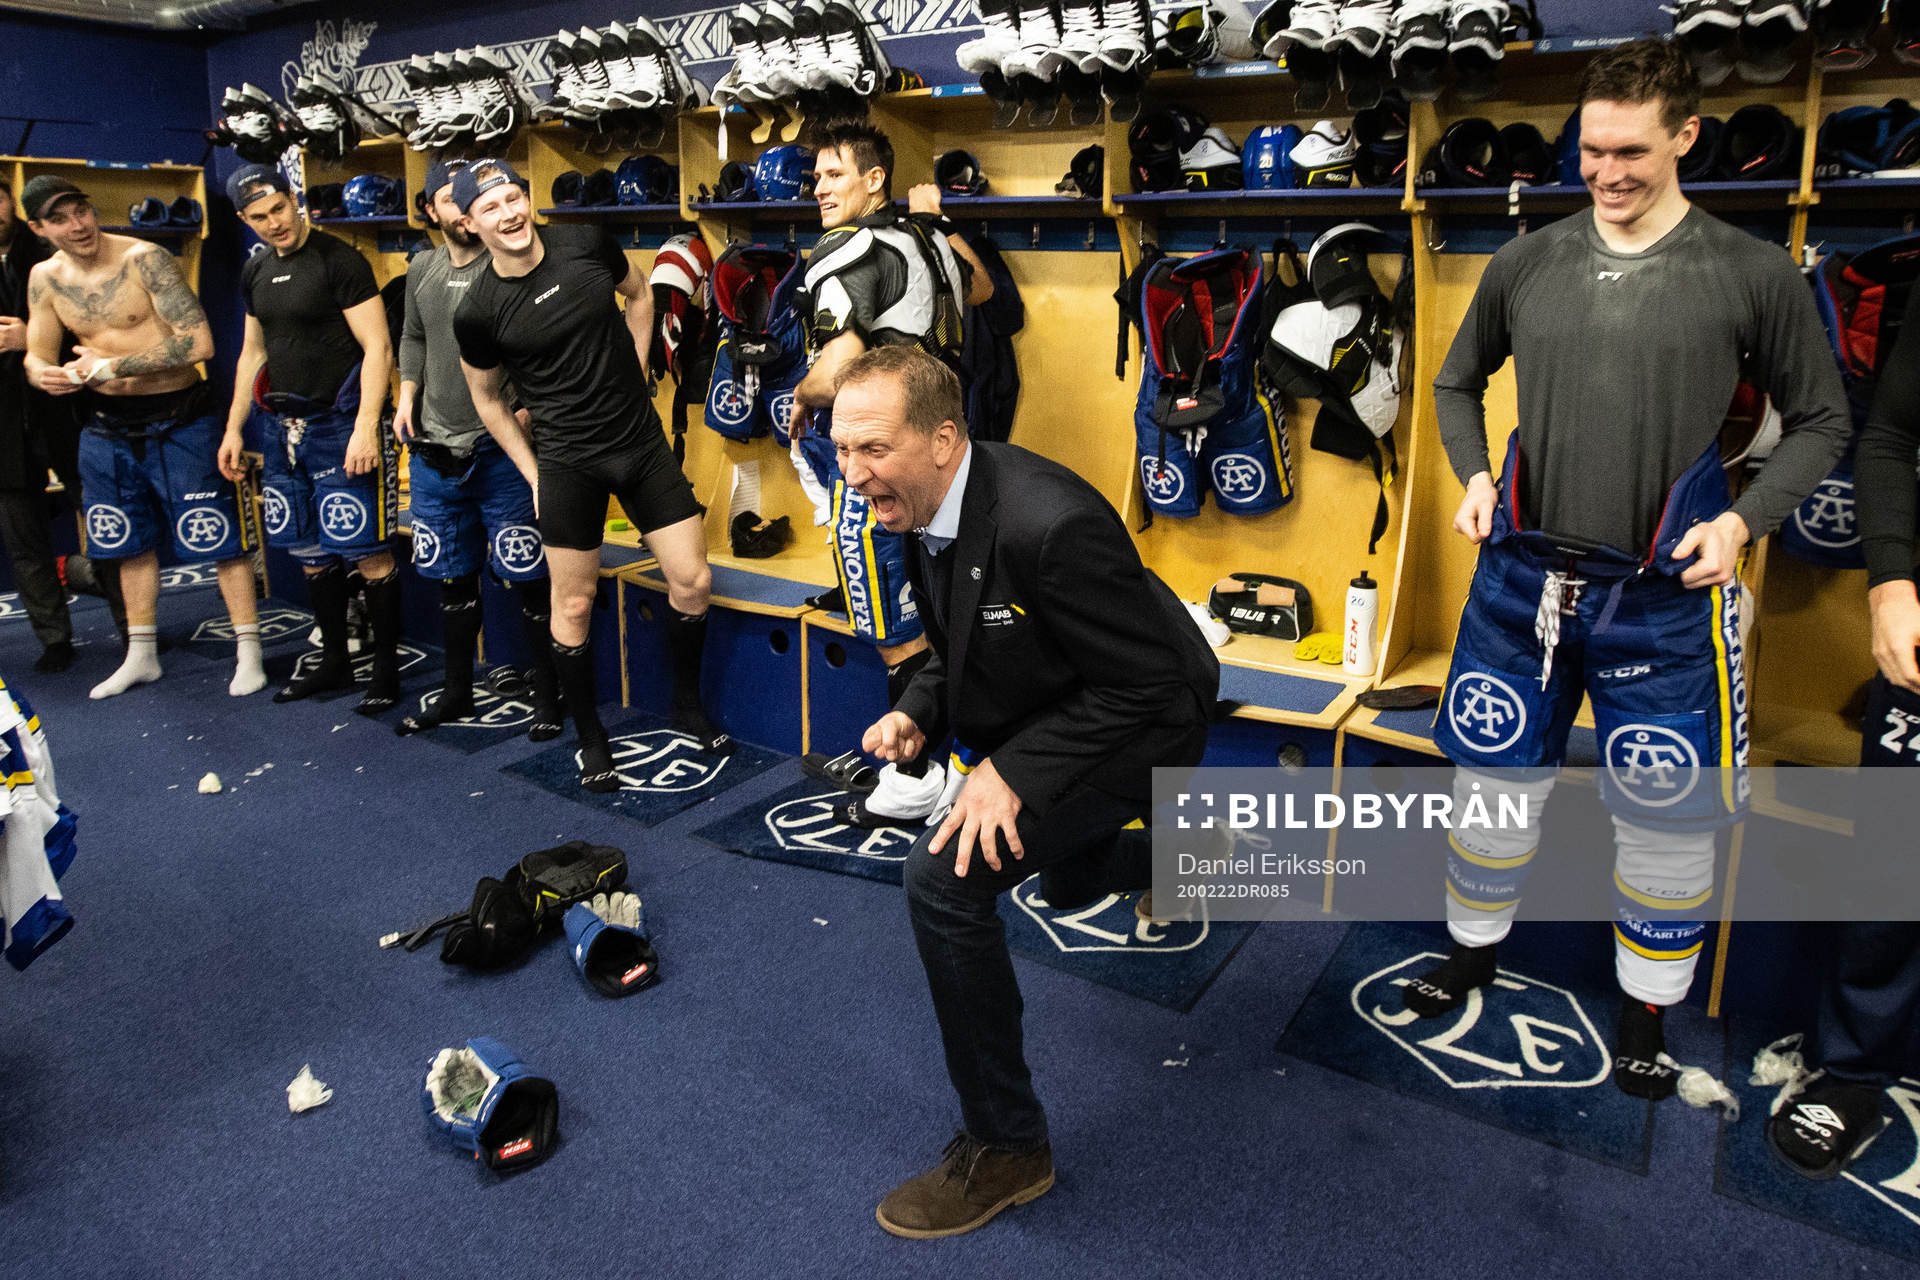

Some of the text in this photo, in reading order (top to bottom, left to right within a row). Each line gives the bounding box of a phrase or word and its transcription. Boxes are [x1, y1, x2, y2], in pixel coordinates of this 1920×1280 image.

[982, 609, 1012, 620] ELMAB
[1348, 618, 1360, 664] CCM
[1598, 663, 1651, 679] CCM
[1646, 886, 1689, 897] CCM
[1616, 1056, 1672, 1079] CCM
[1789, 1112, 1833, 1138] umbro
